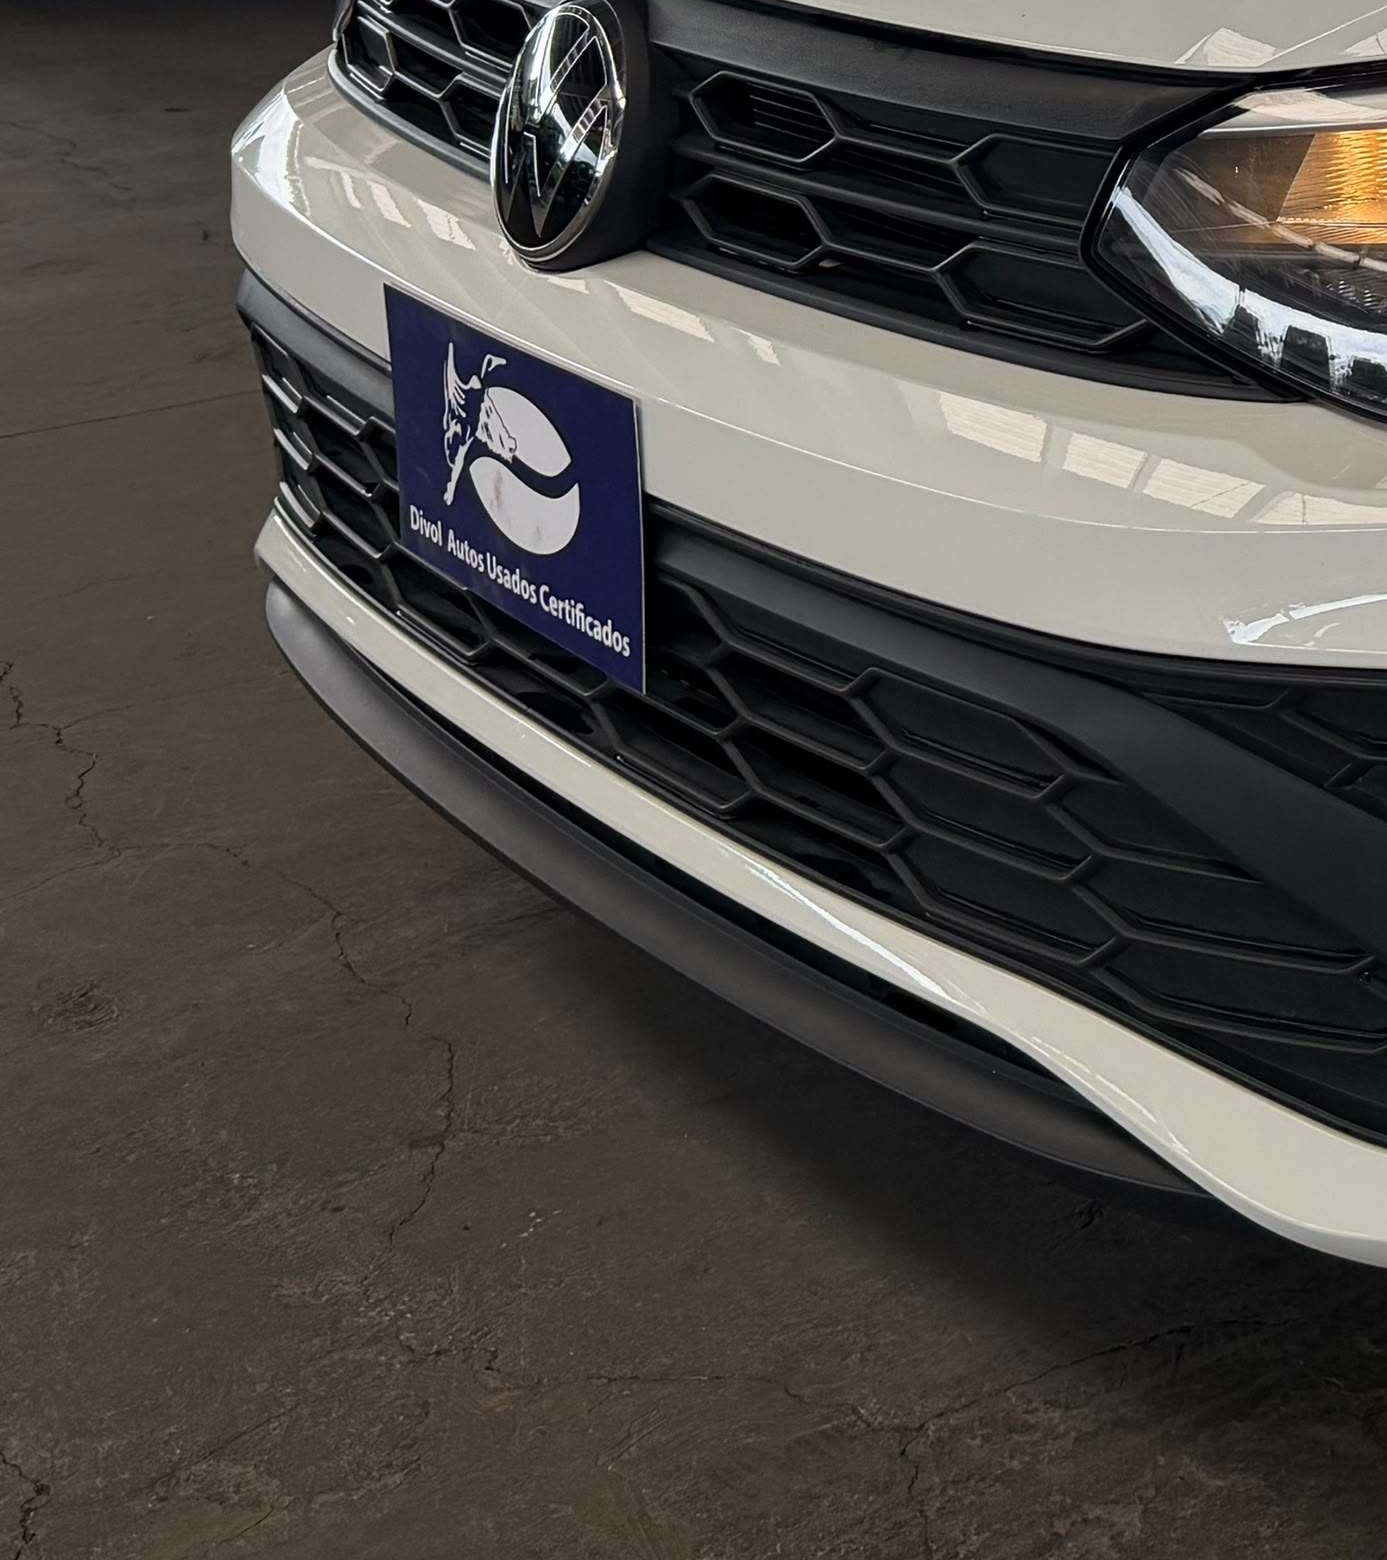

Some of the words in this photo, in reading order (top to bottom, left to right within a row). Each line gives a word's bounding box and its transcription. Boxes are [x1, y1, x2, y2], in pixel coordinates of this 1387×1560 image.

[409, 505, 442, 547] Divol
[447, 529, 484, 573] Autos
[486, 552, 537, 604] Usados
[539, 584, 631, 657] Certificados
